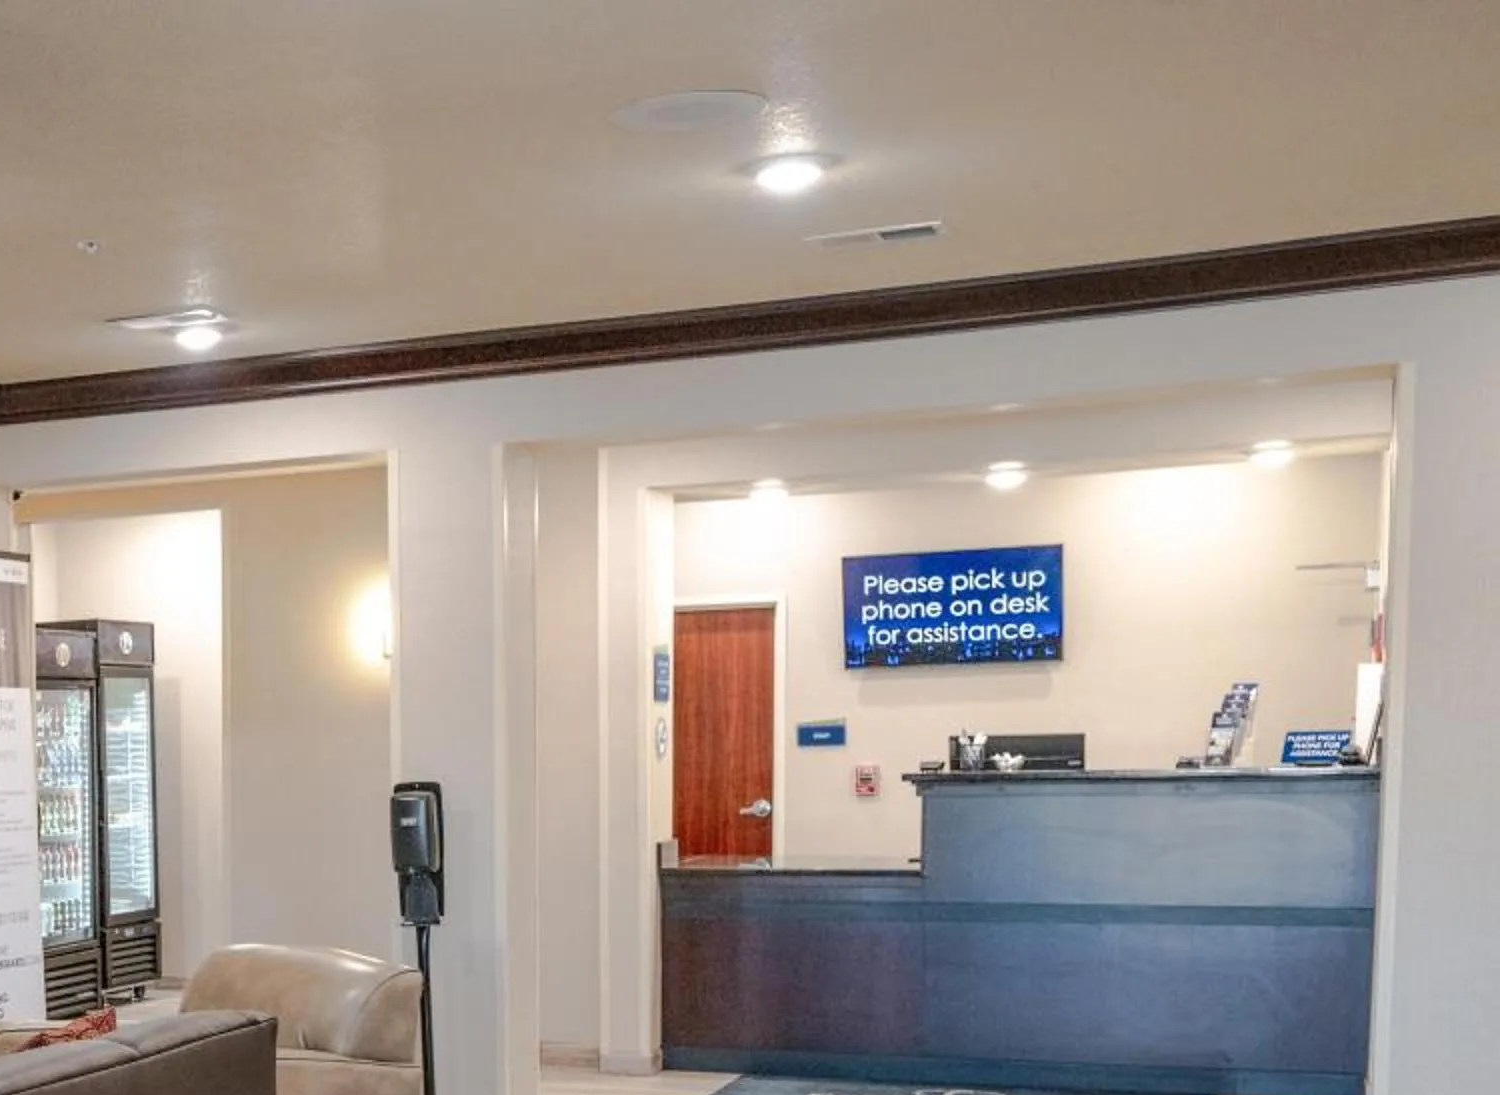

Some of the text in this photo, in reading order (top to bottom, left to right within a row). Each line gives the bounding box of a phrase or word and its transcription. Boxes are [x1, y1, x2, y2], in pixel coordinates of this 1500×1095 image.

[862, 567, 1047, 596] Please pick up
[861, 592, 1051, 625] phone on desk
[867, 621, 1043, 646] for assistance.
[1287, 732, 1349, 742] PLEASE PICK UP
[1293, 741, 1341, 750] PHONE FOR
